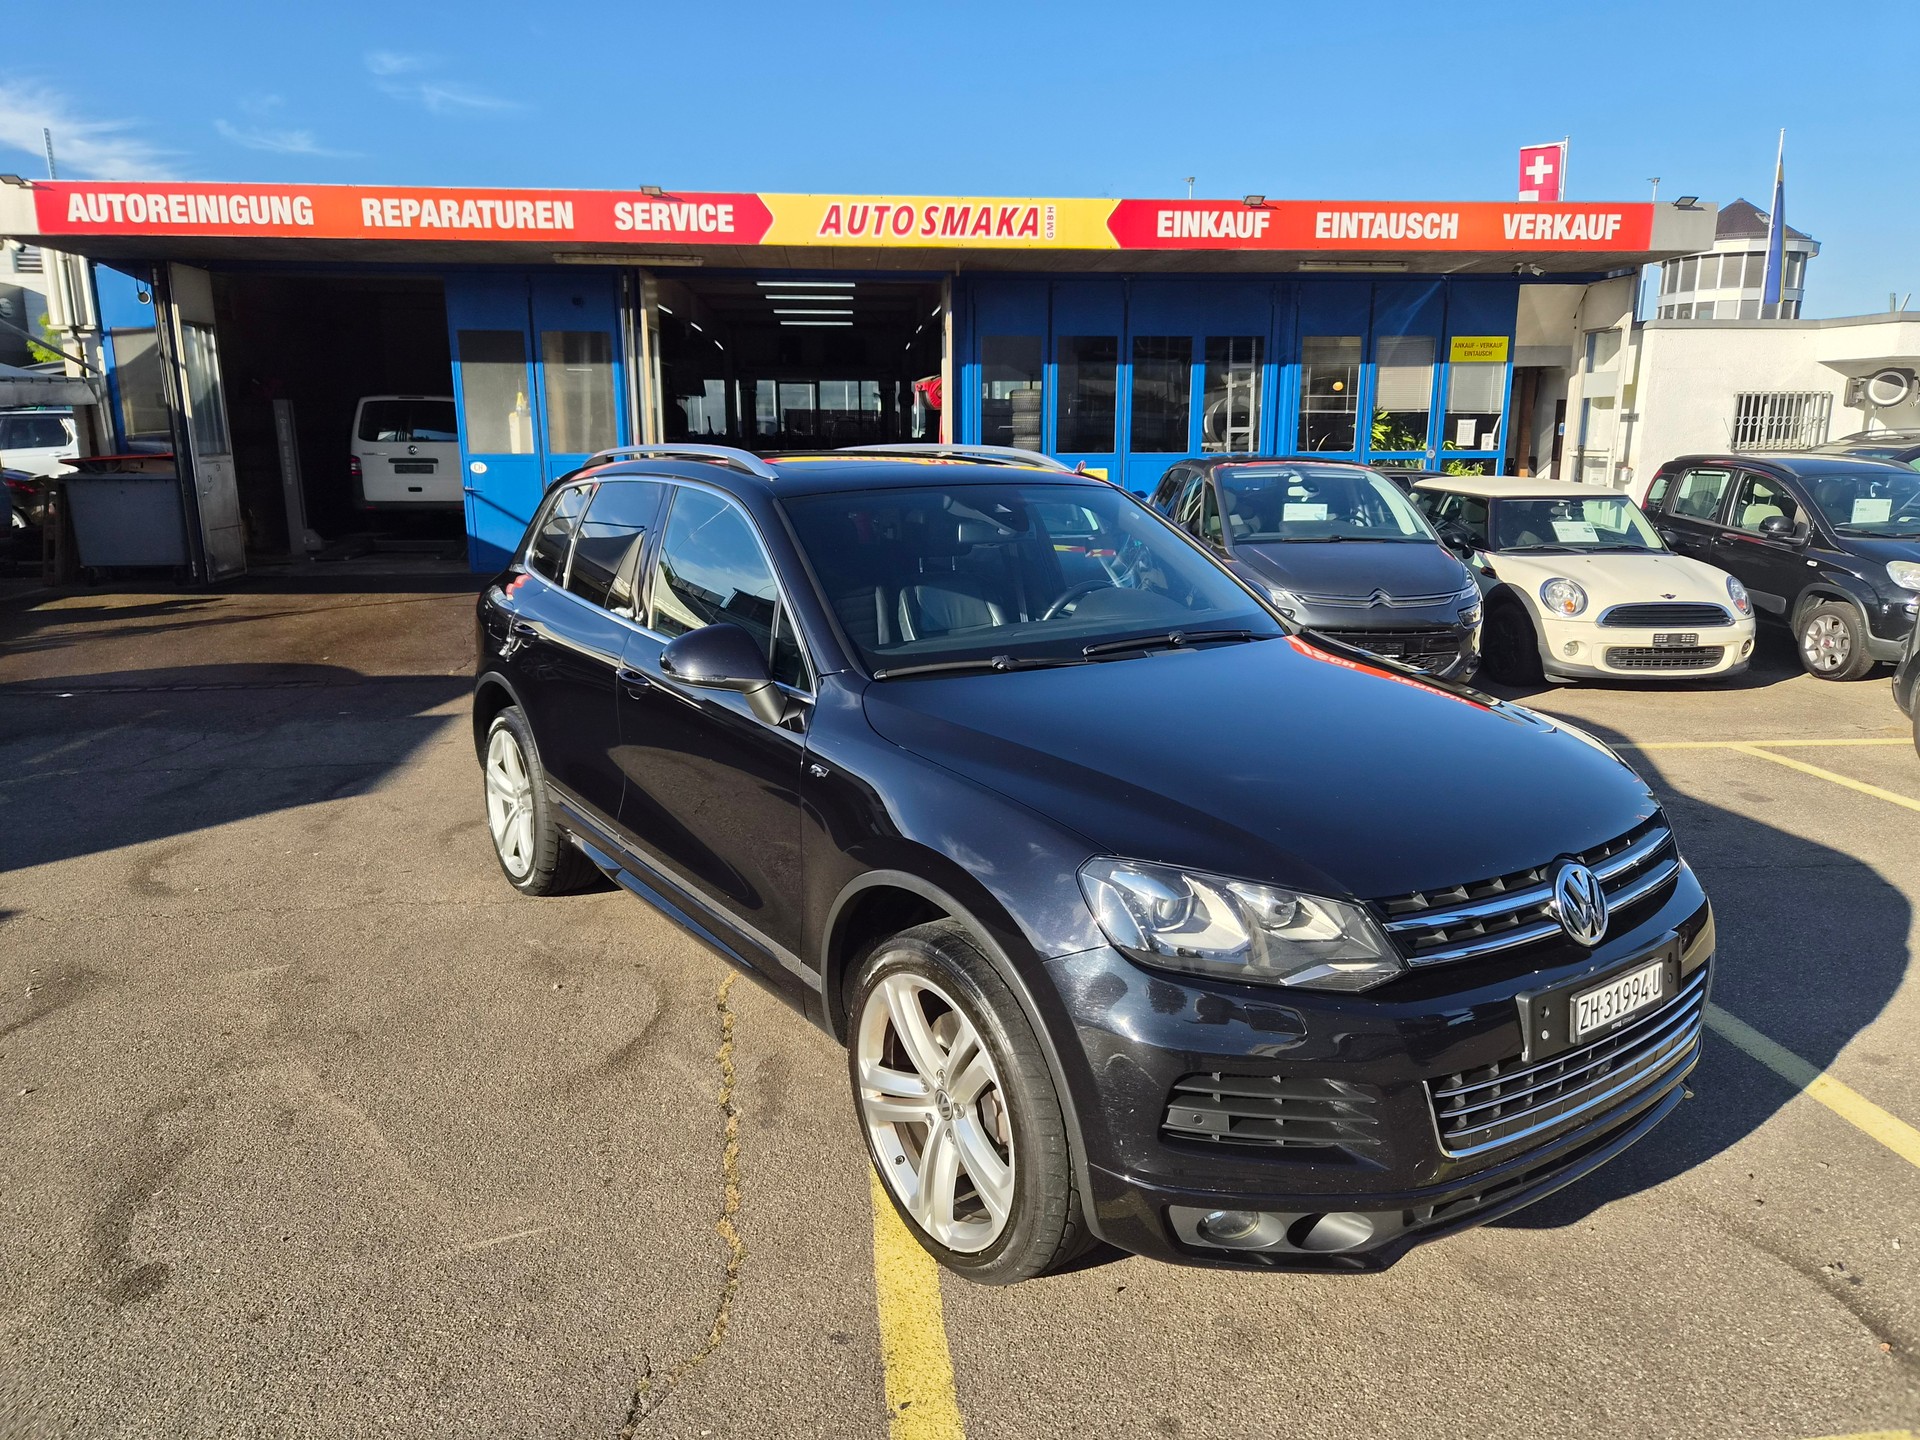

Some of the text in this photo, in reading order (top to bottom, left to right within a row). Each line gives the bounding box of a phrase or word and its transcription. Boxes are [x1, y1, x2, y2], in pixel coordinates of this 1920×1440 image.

[67, 192, 314, 226] AUTOREINIGUNG
[361, 197, 575, 230] REPARATUREN
[613, 201, 735, 233] SERVICE
[819, 204, 1039, 237] AUTO SMAKA
[1157, 210, 1271, 239] EINKAUF
[1315, 211, 1459, 240] EINTAUSCH
[1503, 213, 1622, 241] VERKAUF
